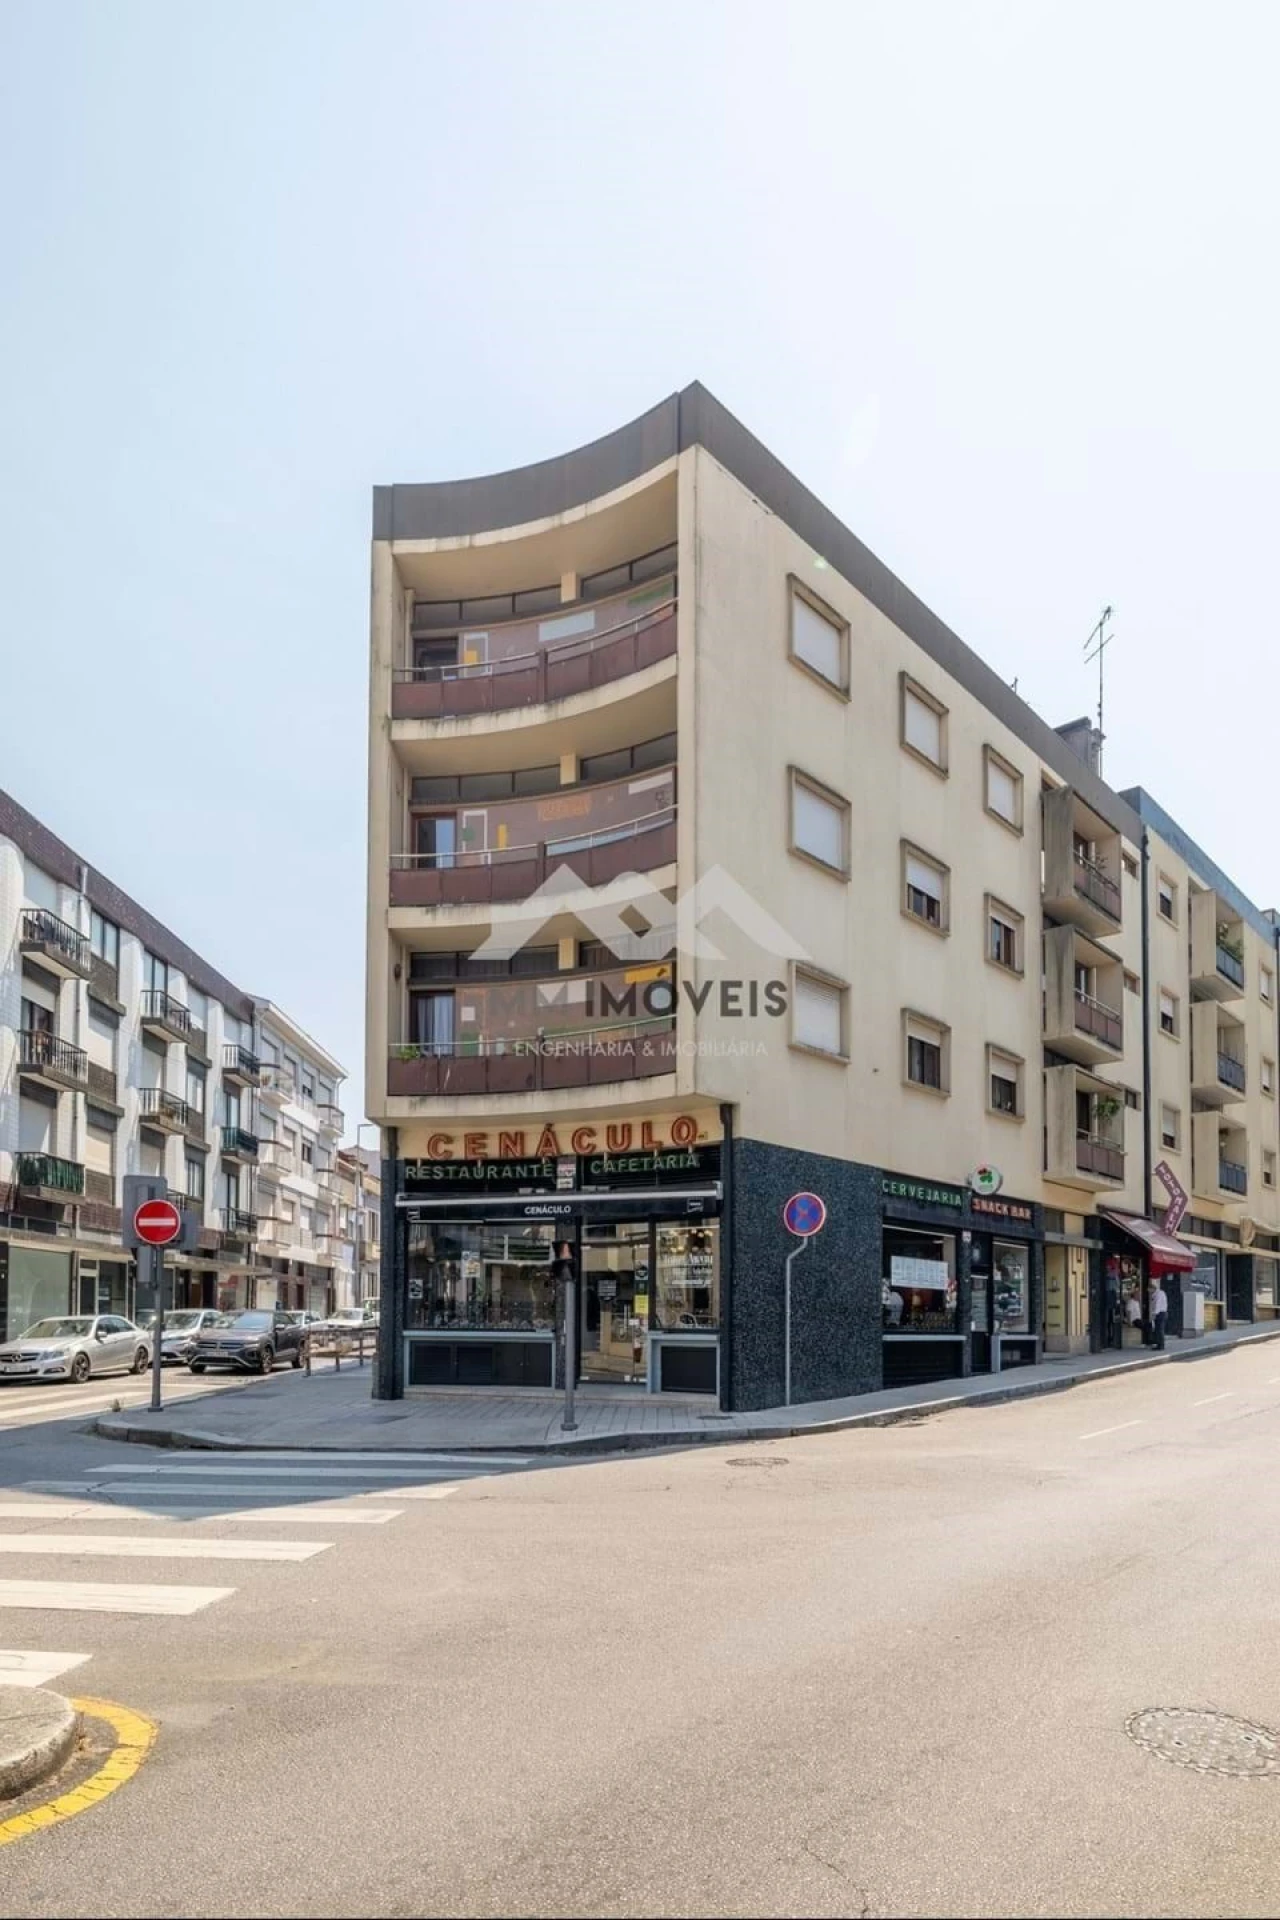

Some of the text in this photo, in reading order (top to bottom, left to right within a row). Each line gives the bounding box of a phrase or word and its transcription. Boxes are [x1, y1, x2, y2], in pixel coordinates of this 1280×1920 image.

[426, 1116, 699, 1160] CENÁCULO
[405, 1164, 553, 1180] RESTAURANTE
[590, 1153, 698, 1174] CAFETARIA
[882, 1179, 962, 1206] CERVEJARIA
[524, 1204, 571, 1215] CENÁCULO
[972, 1198, 1032, 1221] SNACK BAR
